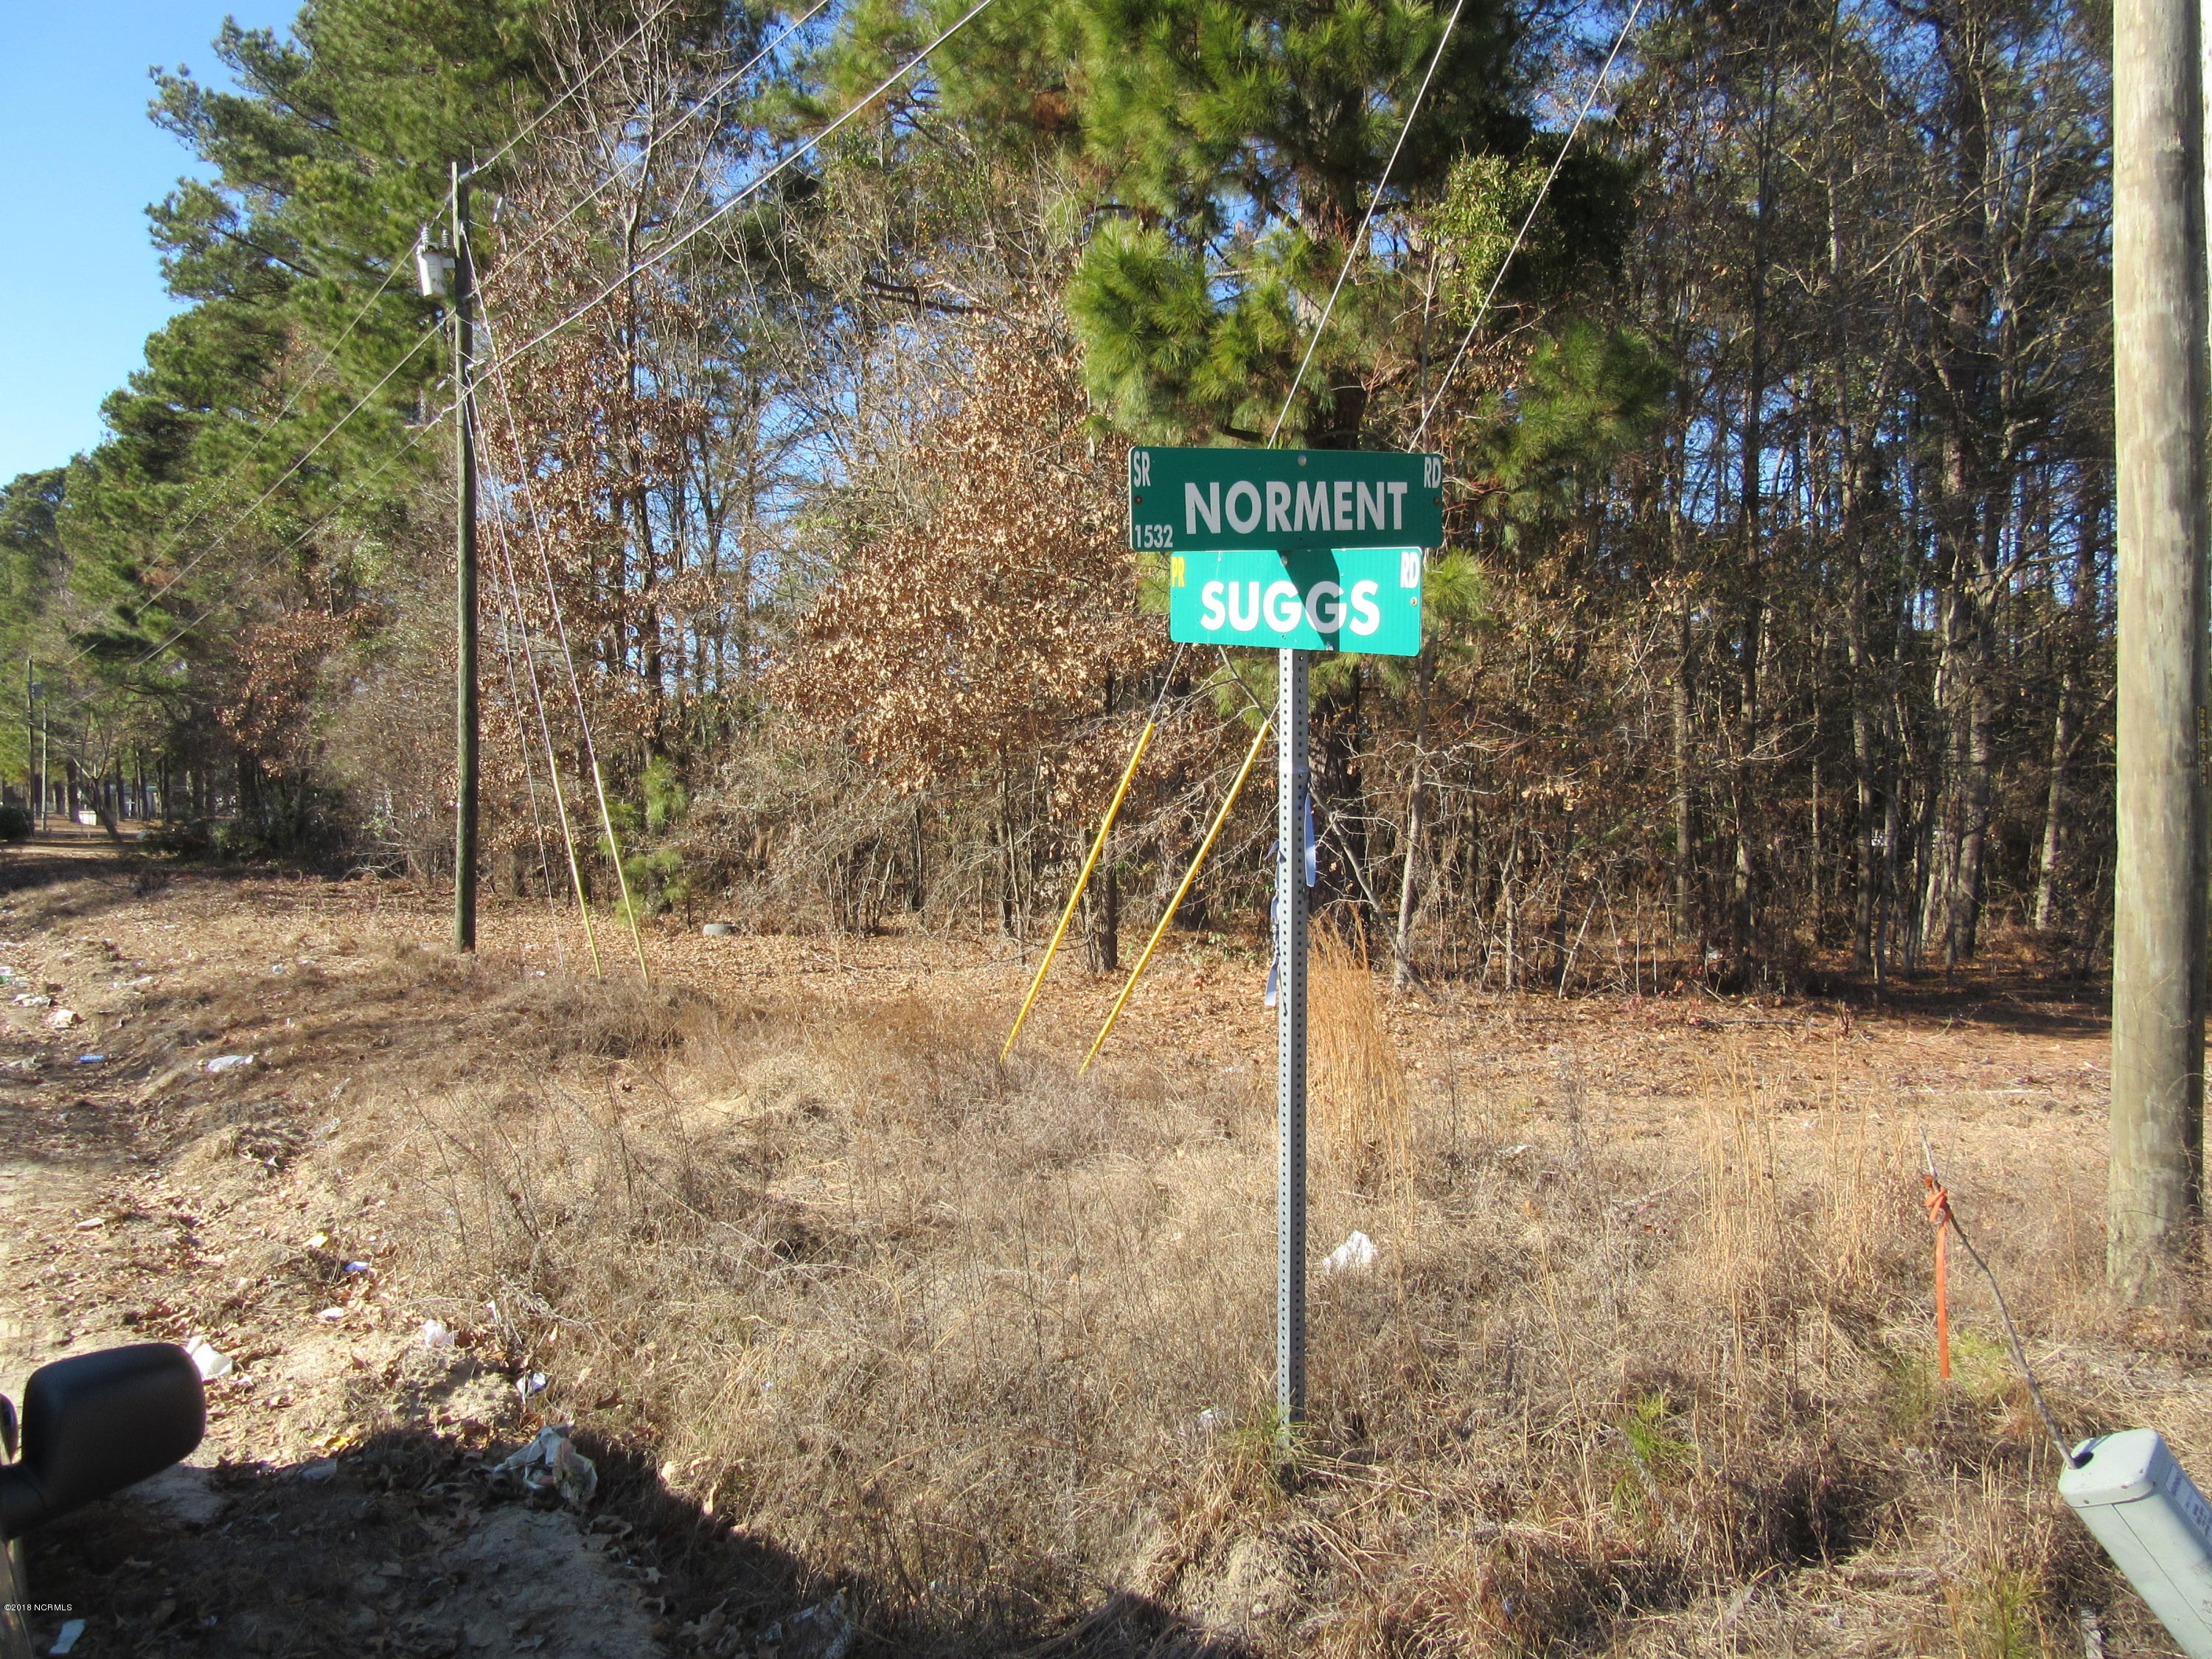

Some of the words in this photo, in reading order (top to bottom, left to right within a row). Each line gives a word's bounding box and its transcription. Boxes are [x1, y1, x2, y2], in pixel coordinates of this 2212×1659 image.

[1133, 451, 1151, 487] SR
[1185, 481, 1408, 535] NORMENT
[1424, 457, 1441, 488] RD
[1135, 524, 1174, 548] 1532
[1172, 557, 1185, 587] PR
[1200, 580, 1380, 636] SUGGS
[1401, 552, 1419, 588] RD
